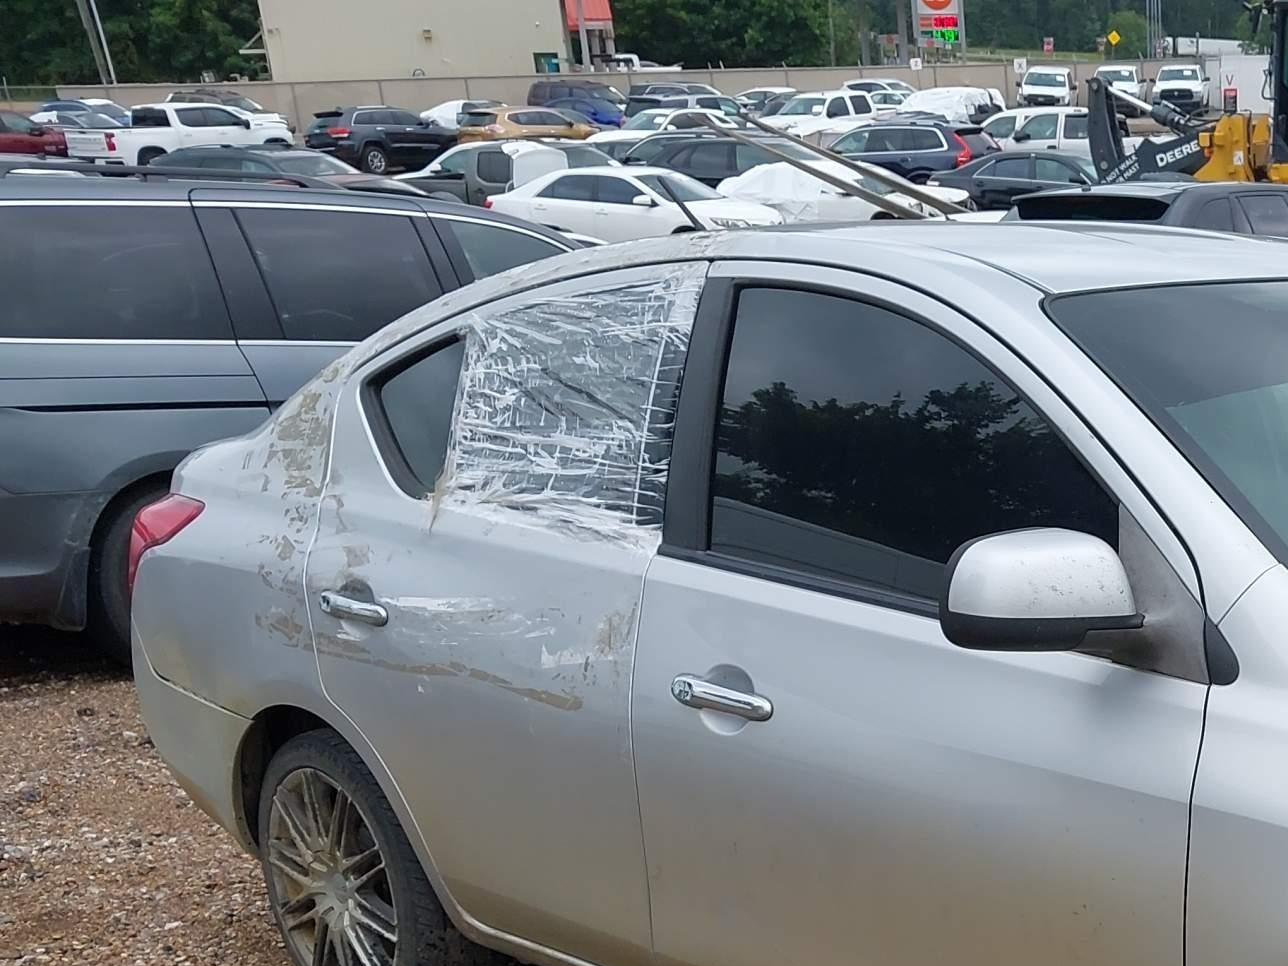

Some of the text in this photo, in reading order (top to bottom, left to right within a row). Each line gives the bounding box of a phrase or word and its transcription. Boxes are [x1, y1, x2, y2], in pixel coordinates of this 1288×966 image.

[1225, 74, 1234, 86] V
[1155, 139, 1201, 168] DEERE
[1105, 167, 1120, 183] NOT
[1119, 154, 1138, 170] WALK
[1123, 162, 1140, 180] MAST
